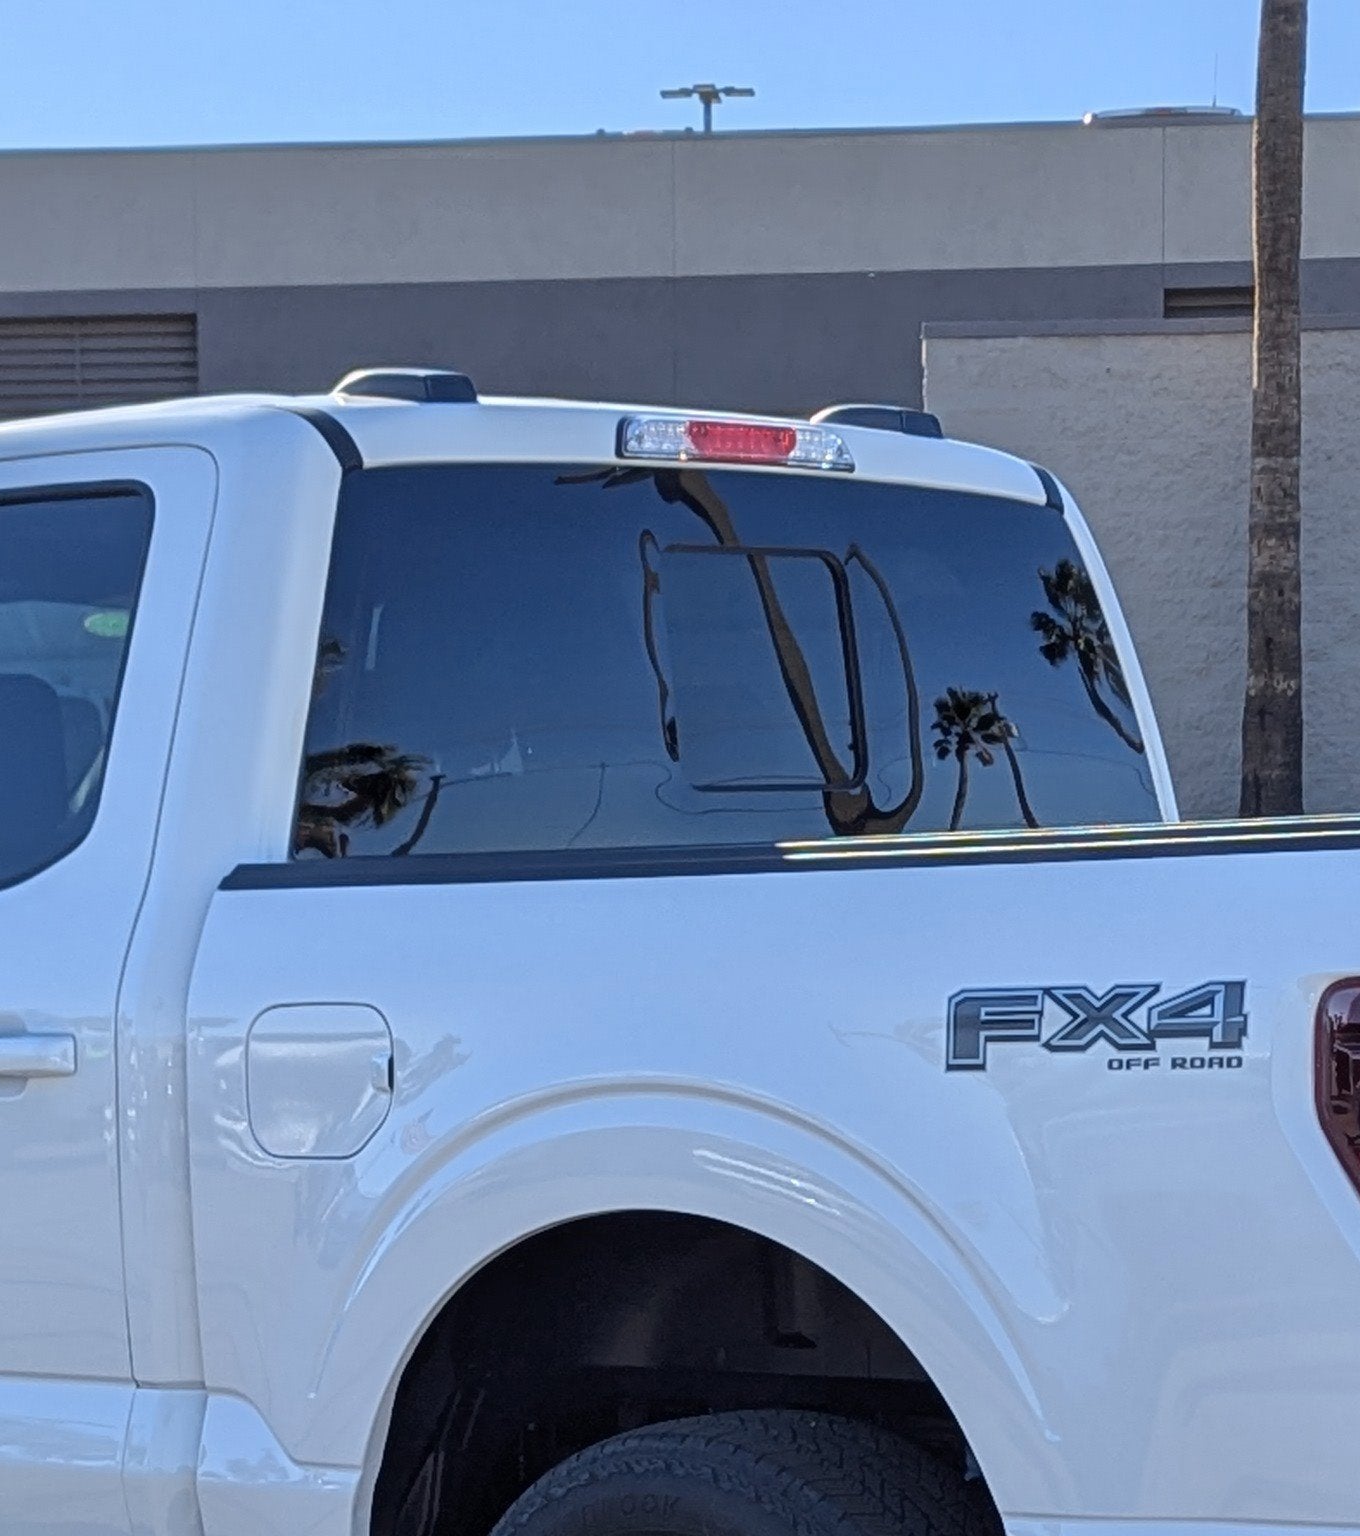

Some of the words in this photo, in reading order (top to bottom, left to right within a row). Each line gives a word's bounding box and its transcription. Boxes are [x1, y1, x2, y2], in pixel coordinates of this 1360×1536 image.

[945, 979, 1248, 1073] FX4
[1106, 1056, 1161, 1071] OFF
[1170, 1055, 1243, 1070] ROAD
